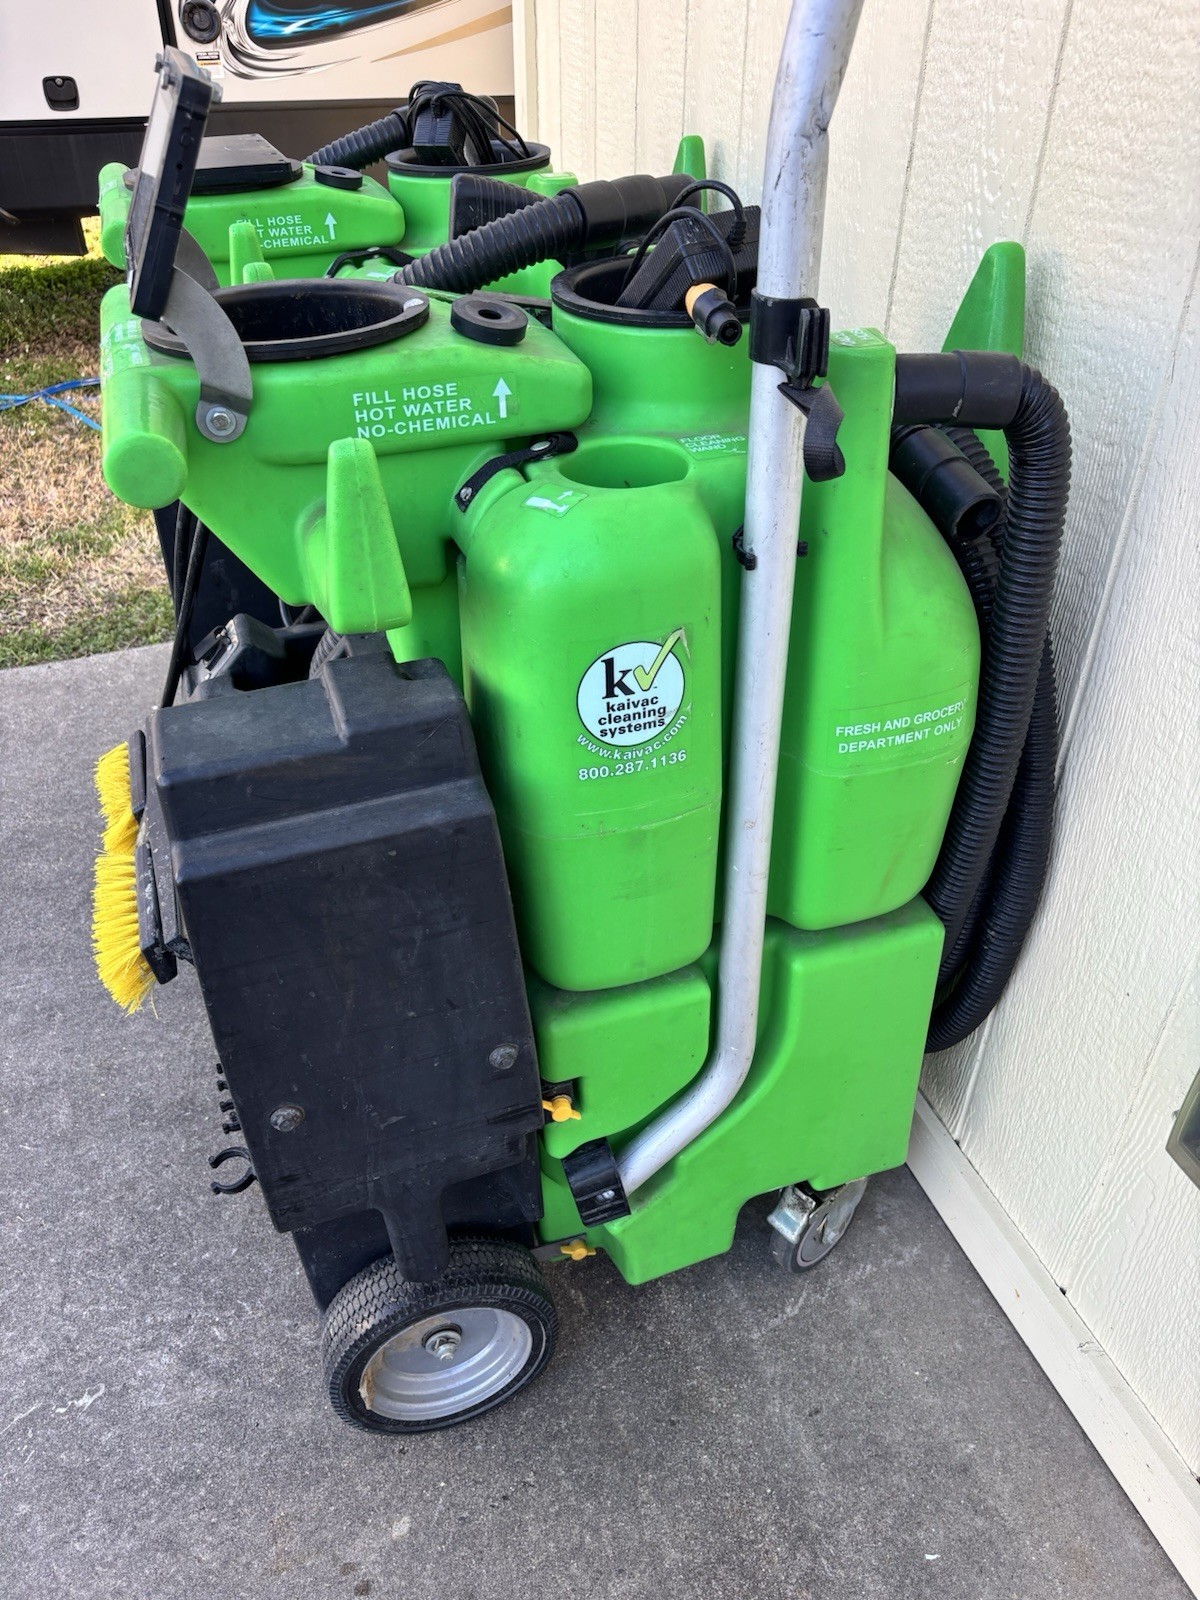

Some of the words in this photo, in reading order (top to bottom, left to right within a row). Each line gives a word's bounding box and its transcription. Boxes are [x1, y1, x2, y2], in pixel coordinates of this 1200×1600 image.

[267, 214, 303, 227] HOSE
[268, 225, 313, 238] WATER
[259, 235, 329, 249] -CHEMICAL
[352, 390, 396, 407] FILL
[402, 382, 458, 401] HOSE
[355, 406, 396, 423] HOT
[402, 397, 472, 418] WATER
[357, 412, 496, 439] NO-CHEMICAL
[680, 434, 721, 443] FLOOR
[598, 705, 667, 726] cleaning
[606, 696, 659, 713] kaivac
[599, 717, 666, 739] systems
[835, 721, 881, 737] FRESH
[883, 716, 911, 731] AND
[913, 698, 967, 725] GROCERY
[576, 715, 687, 760] www.kaivac.com
[838, 728, 931, 754] DEPARTMENT
[934, 716, 963, 736] ONLY
[578, 749, 687, 781] 800.287.1136
